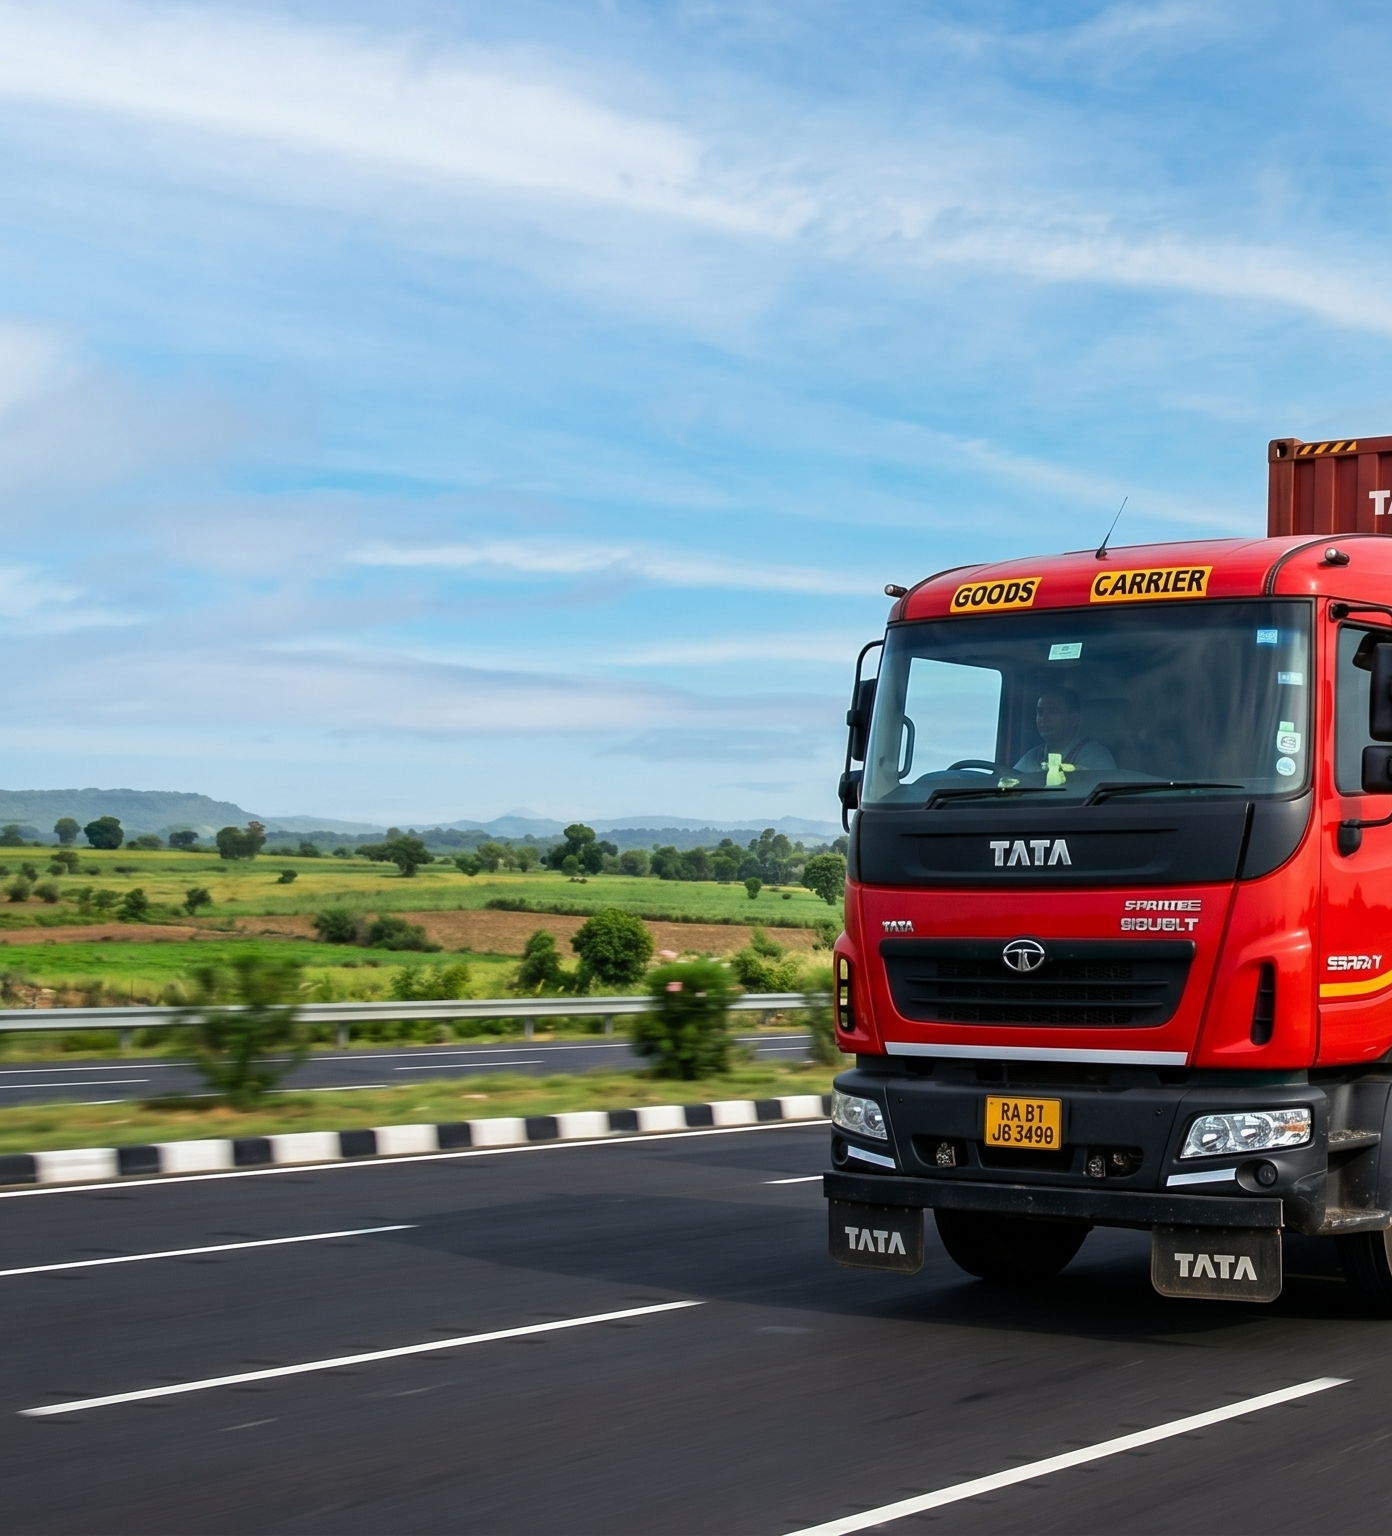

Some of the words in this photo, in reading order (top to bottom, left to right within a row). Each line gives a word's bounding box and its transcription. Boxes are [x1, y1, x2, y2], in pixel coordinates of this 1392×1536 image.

[954, 580, 1036, 608] GOODS
[1094, 569, 1205, 597] CARRIER
[989, 839, 1072, 867] TATA
[881, 920, 915, 932] TATA
[844, 1226, 907, 1256] TATA
[1173, 1252, 1258, 1281] TATA
